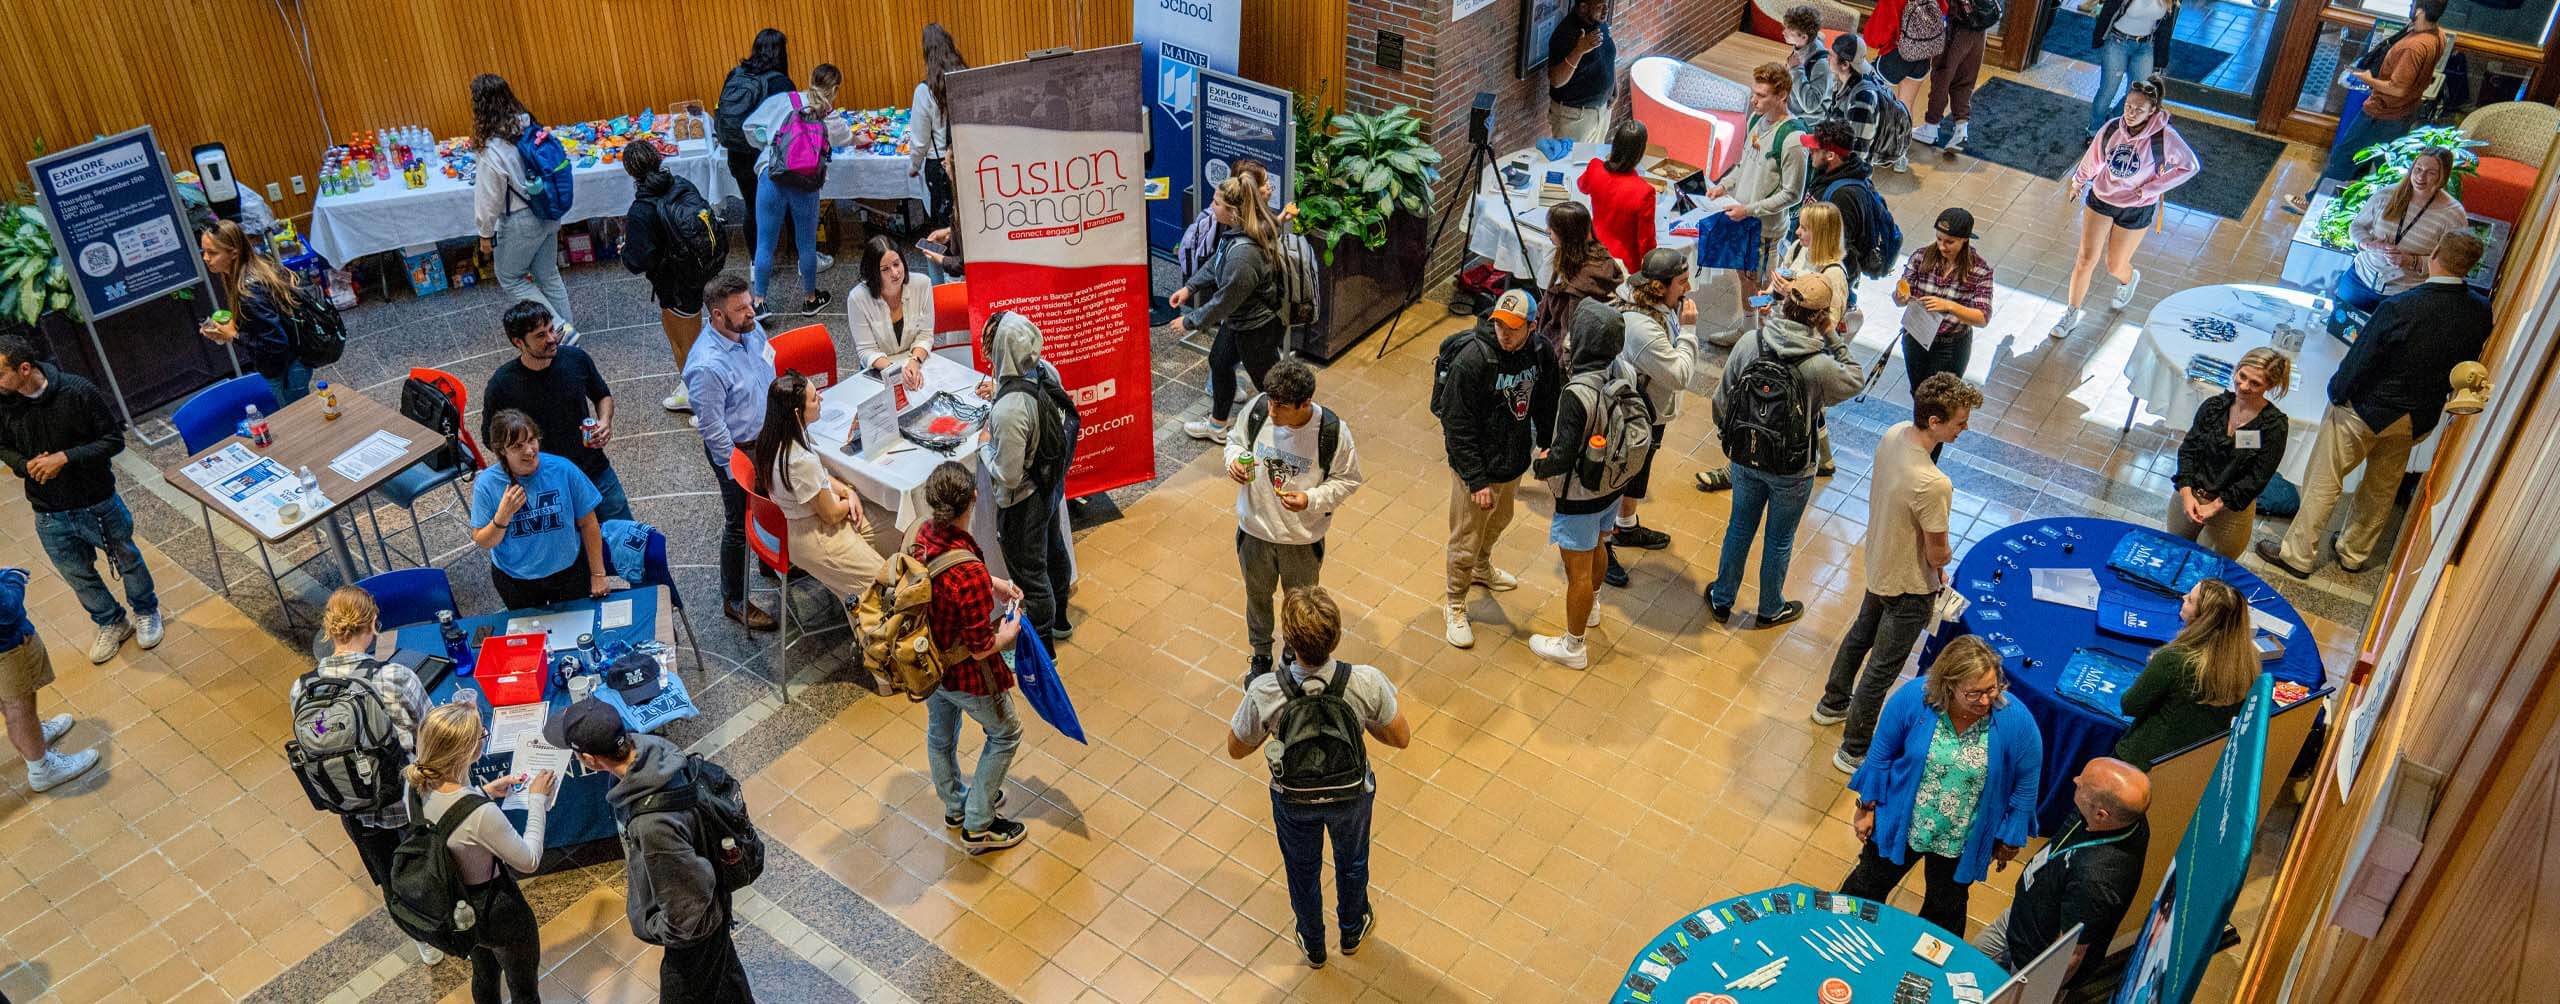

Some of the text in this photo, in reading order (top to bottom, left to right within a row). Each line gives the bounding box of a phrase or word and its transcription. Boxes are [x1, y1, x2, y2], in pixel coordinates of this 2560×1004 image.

[1163, 45, 1206, 67] MAINE
[1209, 86, 1249, 104] EXPLORE
[1209, 94, 1278, 119] CAREERS CASUALLY
[52, 158, 105, 181] EXPLORE
[56, 154, 145, 188] CAREERS CASUALLY
[974, 149, 1128, 199] fusion
[58, 193, 94, 208] Thursday,
[93, 180, 130, 197] September
[64, 203, 104, 220] DPC Atrium
[979, 184, 1128, 245] bangor
[1010, 213, 1122, 240] connect engage transform
[1019, 304, 1040, 314] young
[1073, 293, 1097, 305] FUSION
[1097, 286, 1126, 299] members
[1049, 292, 1073, 303] Bangor
[1093, 278, 1127, 292] networking
[1031, 311, 1045, 319] with
[1082, 300, 1105, 311] engage
[1105, 296, 1115, 304] the
[1042, 317, 1075, 326] transform
[1085, 307, 1108, 319] Bangor
[1108, 302, 1128, 312] region
[1043, 332, 1072, 343] Whether
[1114, 319, 1125, 327] the
[1056, 324, 1074, 334] place
[1095, 315, 1110, 324] work
[1111, 310, 1123, 319] and
[1054, 341, 1069, 350] here
[1070, 339, 1079, 347] all
[1079, 337, 1094, 348] your
[1105, 326, 1130, 338] FUSION
[1056, 349, 1074, 357] make
[1075, 340, 1112, 353] connections
[1112, 336, 1124, 345] and
[2130, 544, 2153, 568] MMG
[2127, 611, 2137, 628] MMG
[624, 668, 644, 685] M
[2079, 666, 2104, 695] MMG
[473, 763, 498, 775] THE
